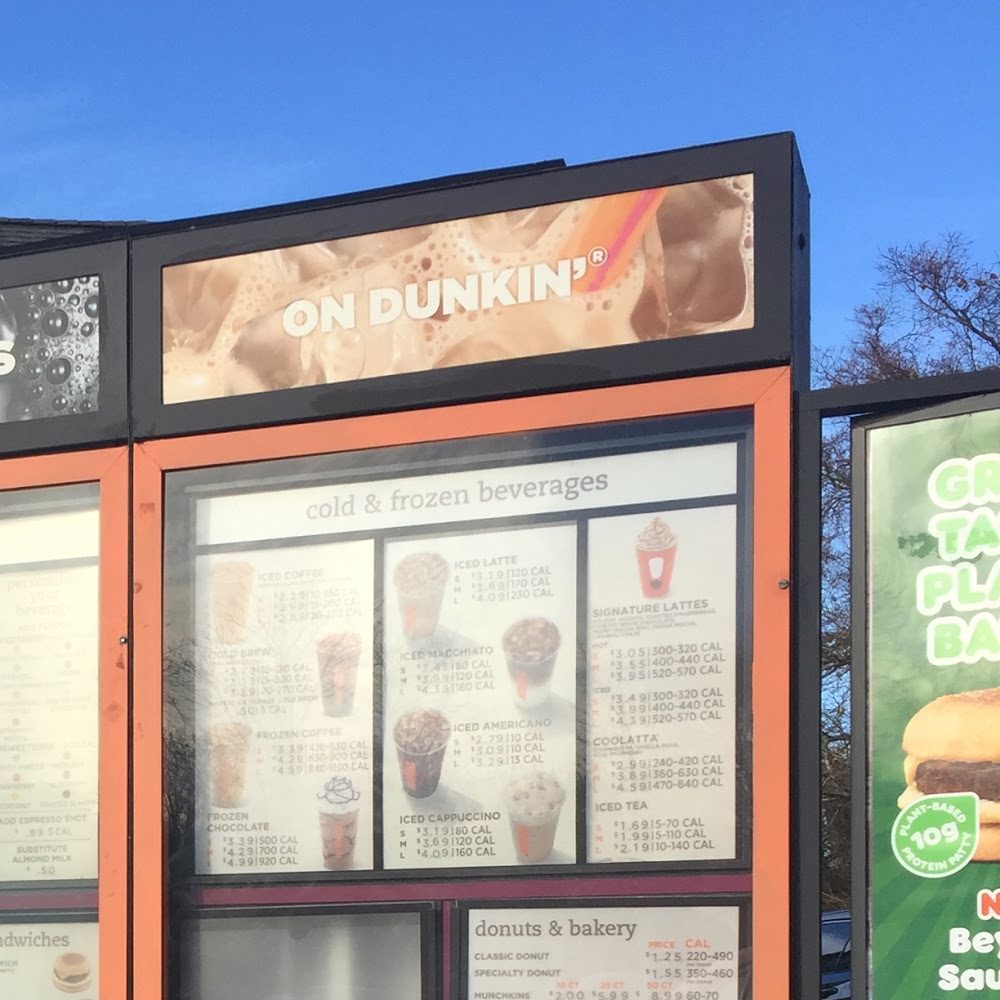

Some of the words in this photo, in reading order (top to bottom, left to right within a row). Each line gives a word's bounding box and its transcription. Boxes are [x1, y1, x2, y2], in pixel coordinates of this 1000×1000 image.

[282, 293, 355, 337] ON
[306, 496, 355, 519] cold
[364, 493, 382, 514] &
[390, 488, 470, 512] frozen
[478, 473, 608, 501] beverages
[455, 560, 480, 569] ICED
[483, 556, 518, 567] LATTE
[593, 604, 659, 617] SIGNATURE
[664, 599, 708, 611] LATTES
[701, 642, 723, 651] CAL
[401, 652, 425, 661] ICED
[428, 647, 493, 658] MACCHIATO
[454, 723, 479, 732] ICED
[483, 719, 551, 730] AMERICANO
[257, 731, 299, 739] FROZEN
[302, 728, 342, 738] COFFEE
[593, 734, 658, 746] COOLATTA
[596, 803, 622, 811] ICED
[626, 801, 647, 810] TEA
[208, 813, 248, 821] FROZEN
[400, 816, 425, 824] ICED
[429, 812, 500, 822] CAPPUCCINO
[900, 802, 966, 836] PLANT-BASED
[208, 823, 269, 832] CHOCOLATE
[911, 821, 959, 850] 10g
[693, 840, 715, 849] CAL
[902, 847, 948, 870] PROTEIN
[948, 832, 972, 865] PATTY
[475, 920, 541, 936] donuts
[548, 921, 563, 936] &
[569, 919, 637, 940] bakery
[685, 939, 711, 948] CAL
[687, 951, 733, 961] 220-490
[474, 970, 524, 978] SPECIALTY
[687, 969, 733, 978] 350-460
[474, 992, 530, 1000] MUNCHKINS
